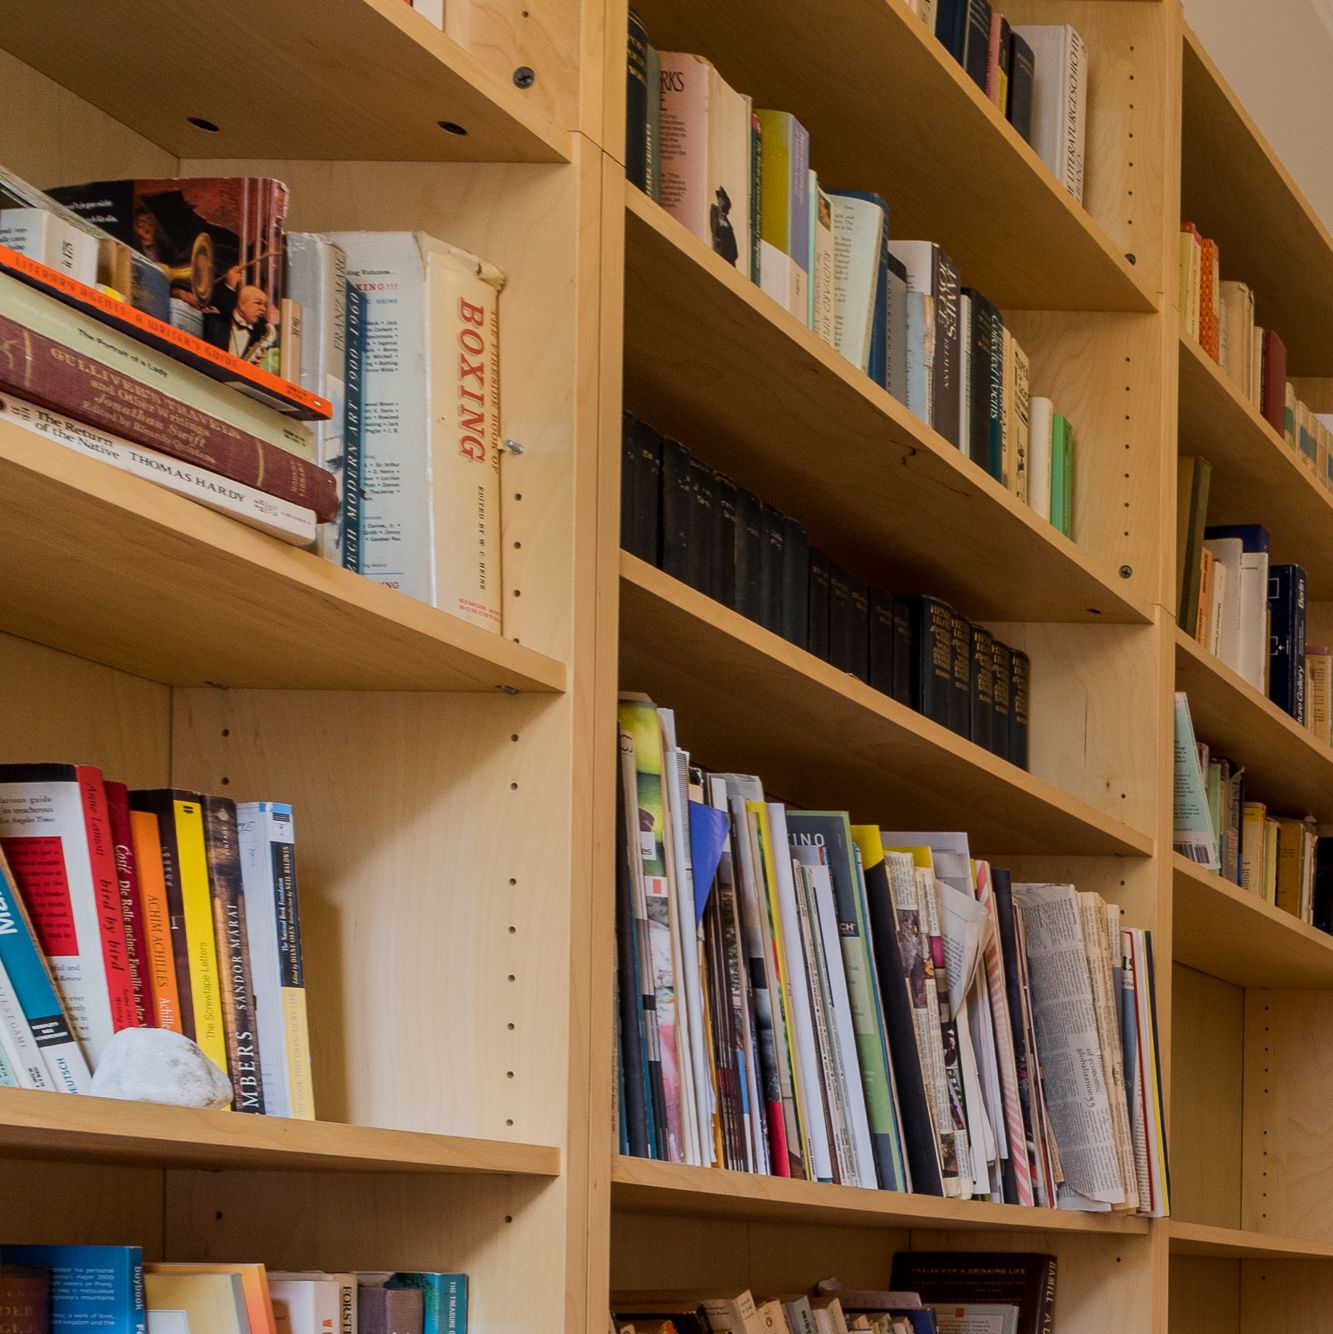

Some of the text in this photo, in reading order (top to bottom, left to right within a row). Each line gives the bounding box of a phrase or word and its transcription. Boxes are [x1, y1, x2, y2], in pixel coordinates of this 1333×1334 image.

[945, 263, 958, 341] JAMES
[50, 347, 242, 440] GULLIVER'S TRAVELS
[459, 297, 486, 464] BOXING
[94, 395, 207, 449] Jonathan Swift
[347, 291, 362, 521] MODERN ART 1900-1960
[35, 420, 121, 461] of the Native
[36, 409, 114, 448] The Return
[127, 450, 247, 504] THOMAS HARDY
[478, 485, 486, 519] EDITED
[1297, 578, 1306, 610] Berlin
[1296, 664, 1306, 706] Gallery
[87, 782, 105, 857] Anne Lamott
[101, 878, 125, 972] bird by bird
[121, 897, 135, 924] Rolle
[124, 925, 138, 957] meiner
[147, 894, 170, 988] ACHIM ACHILLES
[128, 957, 144, 992] Familie
[200, 941, 216, 1040] The Screwtape Letters
[237, 1030, 261, 1110] MBERS
[1088, 1058, 1102, 1093] economic
[133, 1266, 144, 1311] buybook
[449, 1280, 457, 1294] THE
[1046, 1261, 1057, 1304] HAMILL
[449, 1295, 457, 1329] TREASURE
